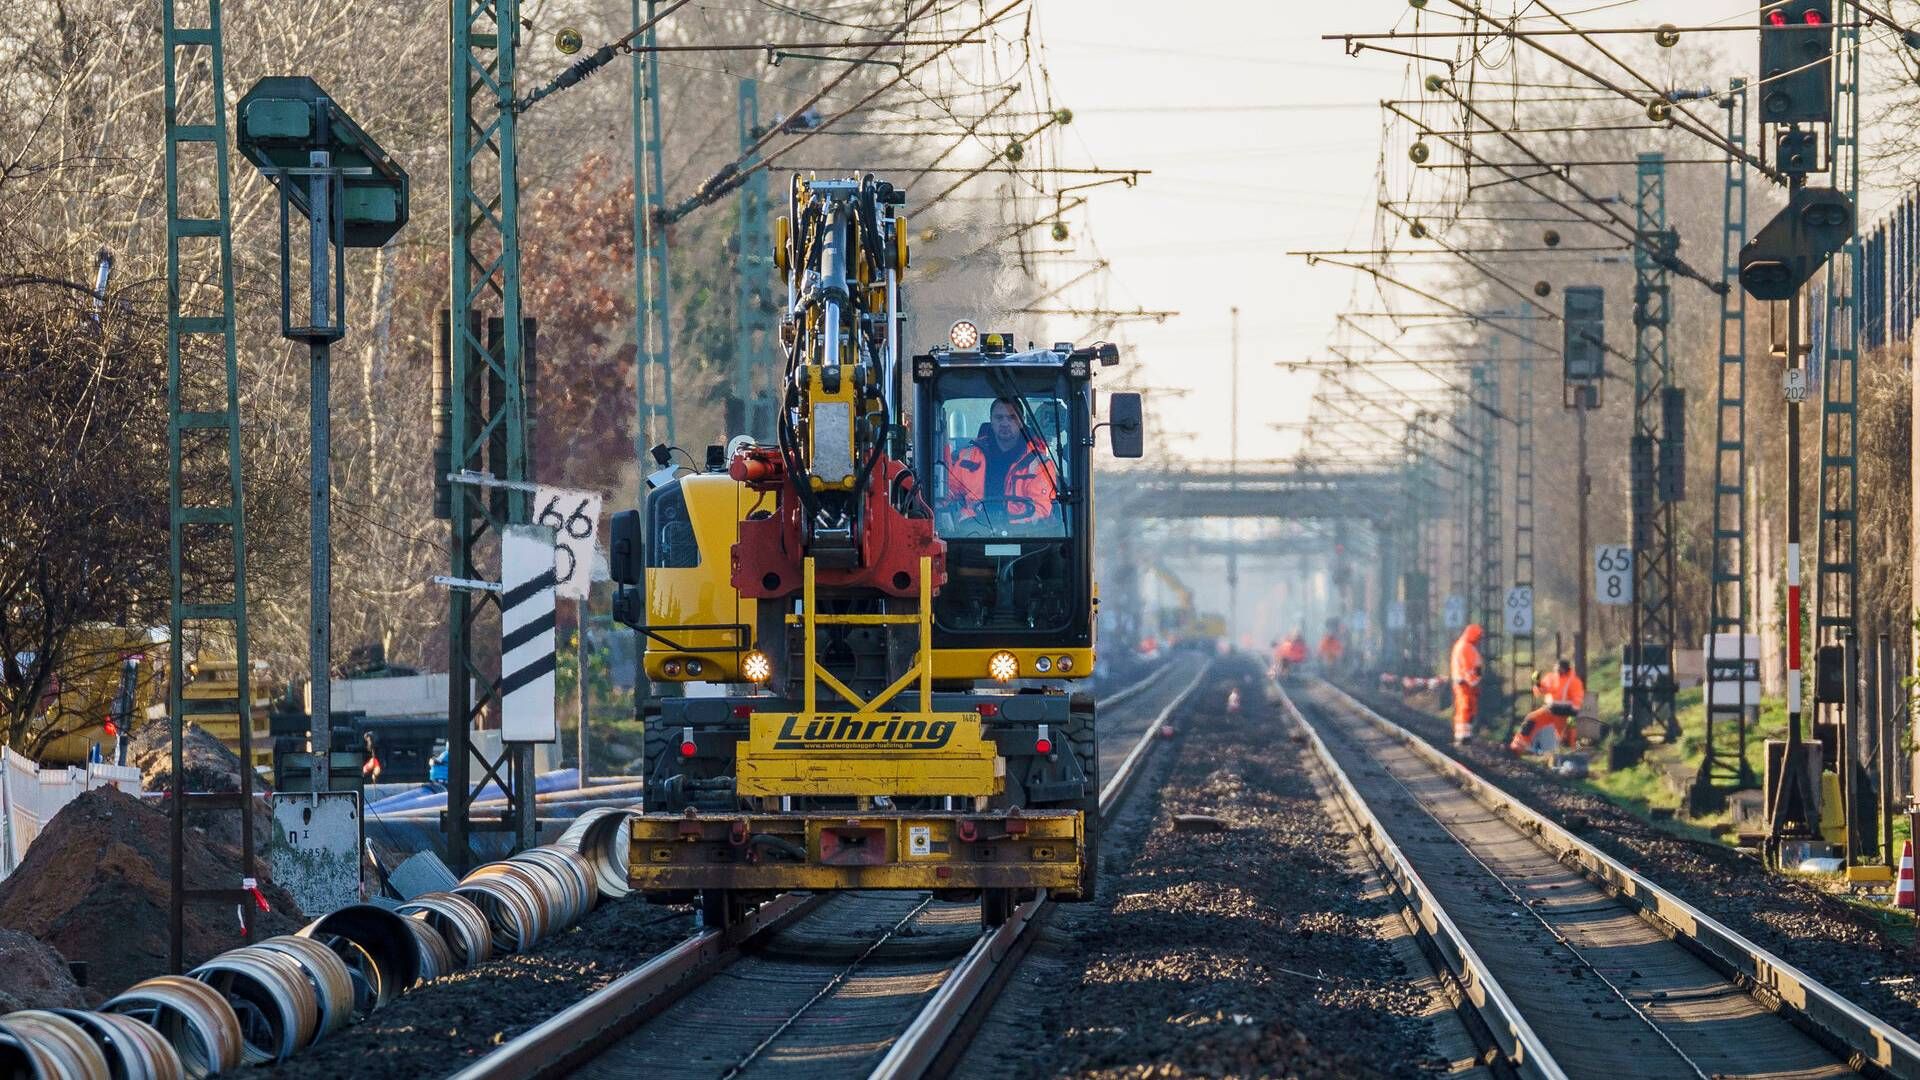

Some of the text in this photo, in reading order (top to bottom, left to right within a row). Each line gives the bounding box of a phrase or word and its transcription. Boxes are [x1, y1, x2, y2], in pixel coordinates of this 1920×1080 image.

[1790, 371, 1800, 385] P
[1784, 386, 1806, 400] 202
[539, 495, 593, 539] 66
[1598, 548, 1631, 572] 65
[1607, 575, 1622, 598] 8
[1507, 590, 1531, 609] 65
[1512, 610, 1525, 628] 6
[776, 715, 958, 749] Lühring
